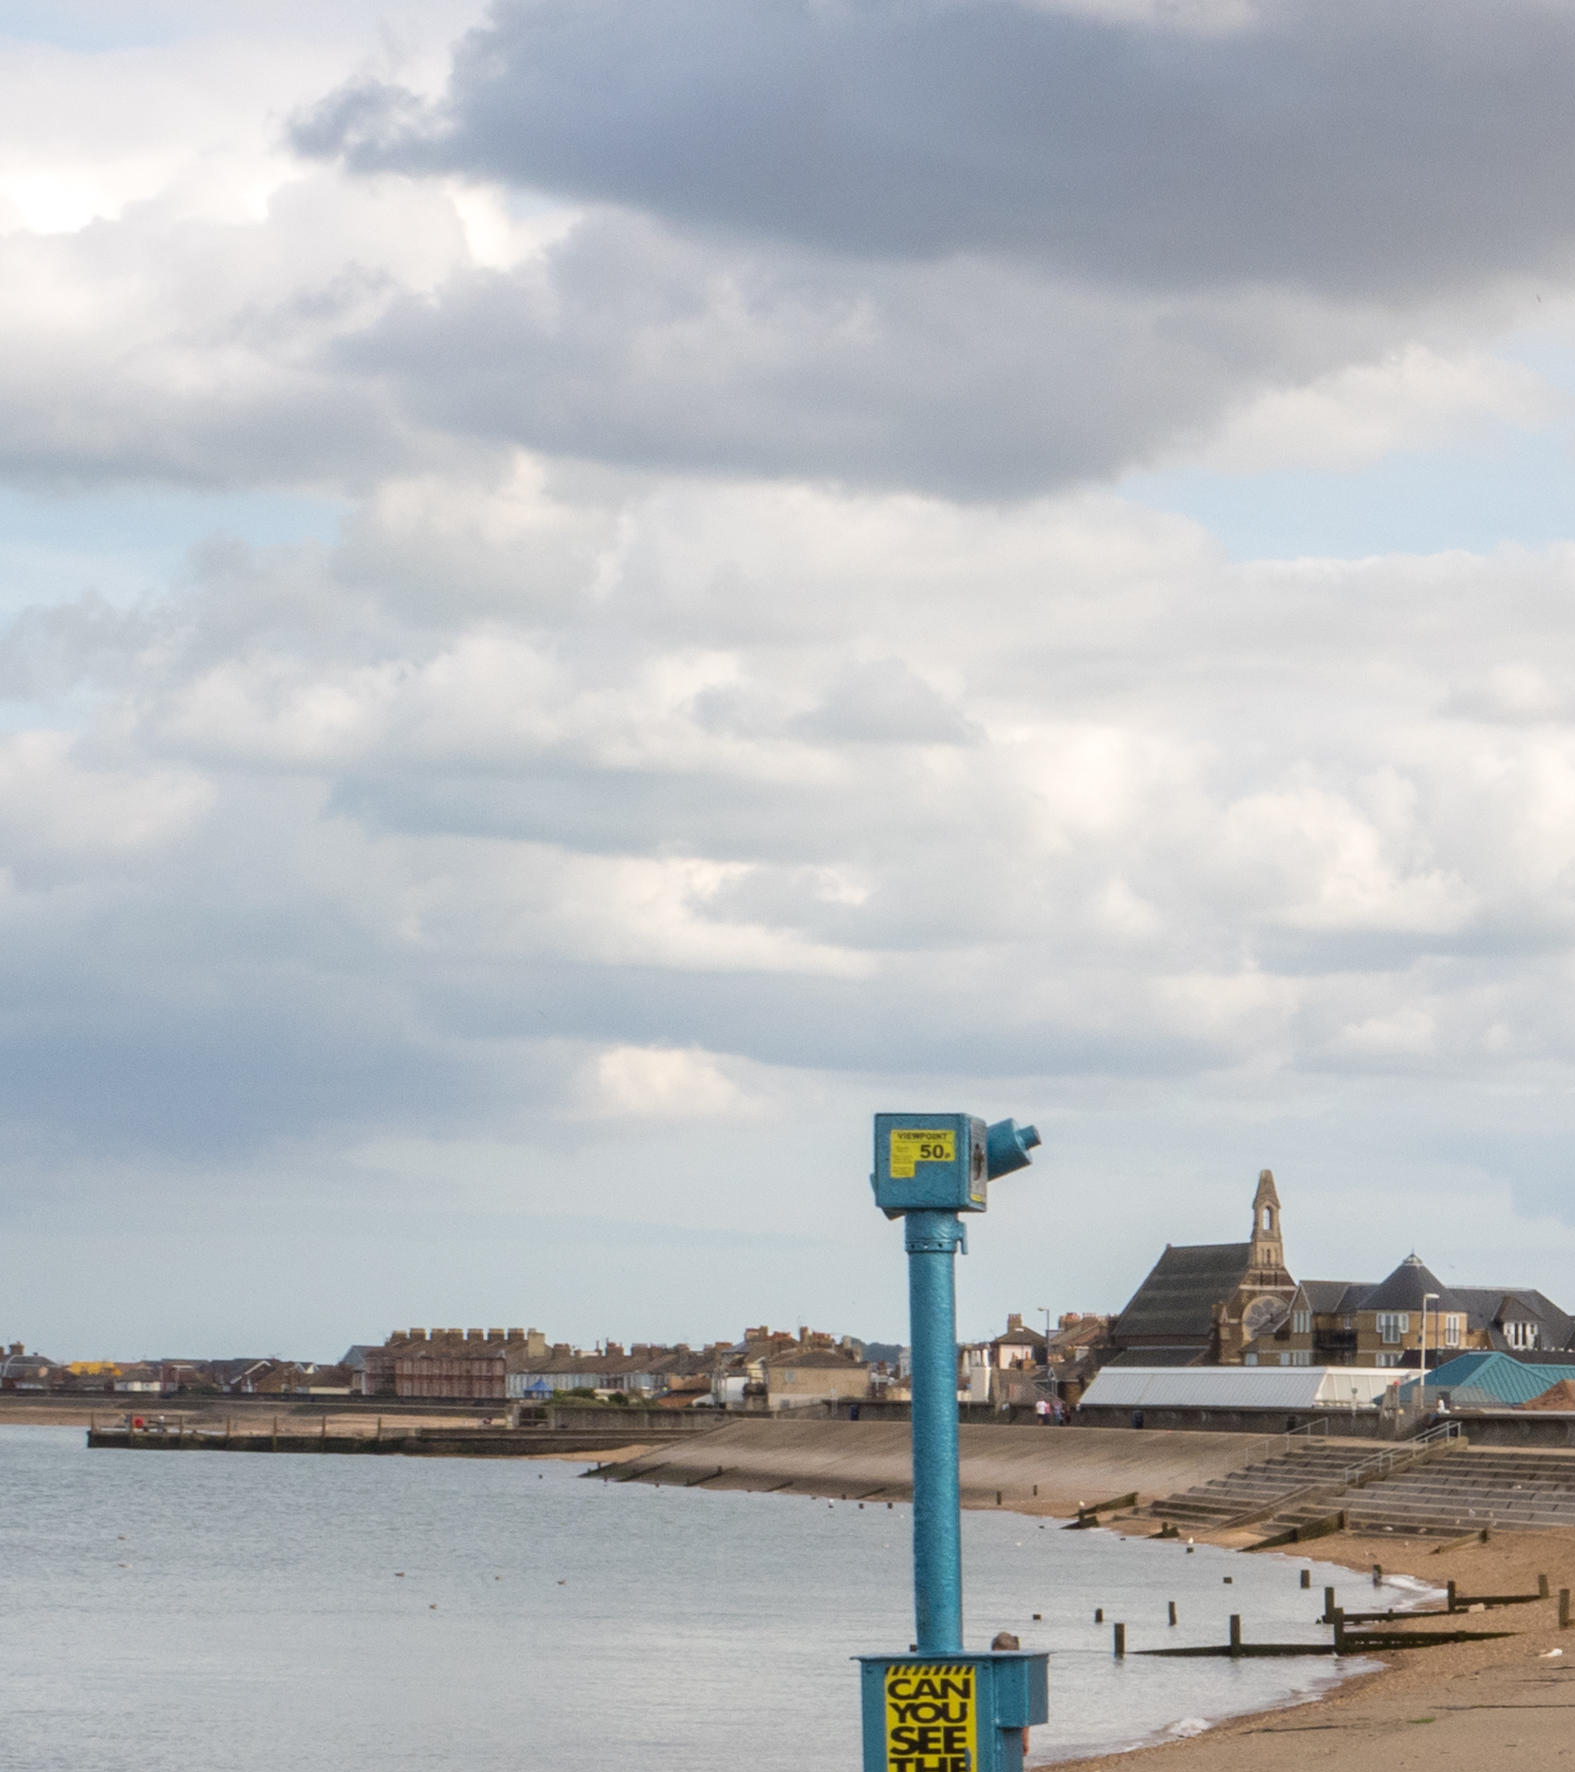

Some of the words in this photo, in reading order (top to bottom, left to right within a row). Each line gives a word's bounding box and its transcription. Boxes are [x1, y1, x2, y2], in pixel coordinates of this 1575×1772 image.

[887, 1677, 971, 1700] CAN
[888, 1702, 968, 1724] YOU
[890, 1726, 967, 1755] SEE
